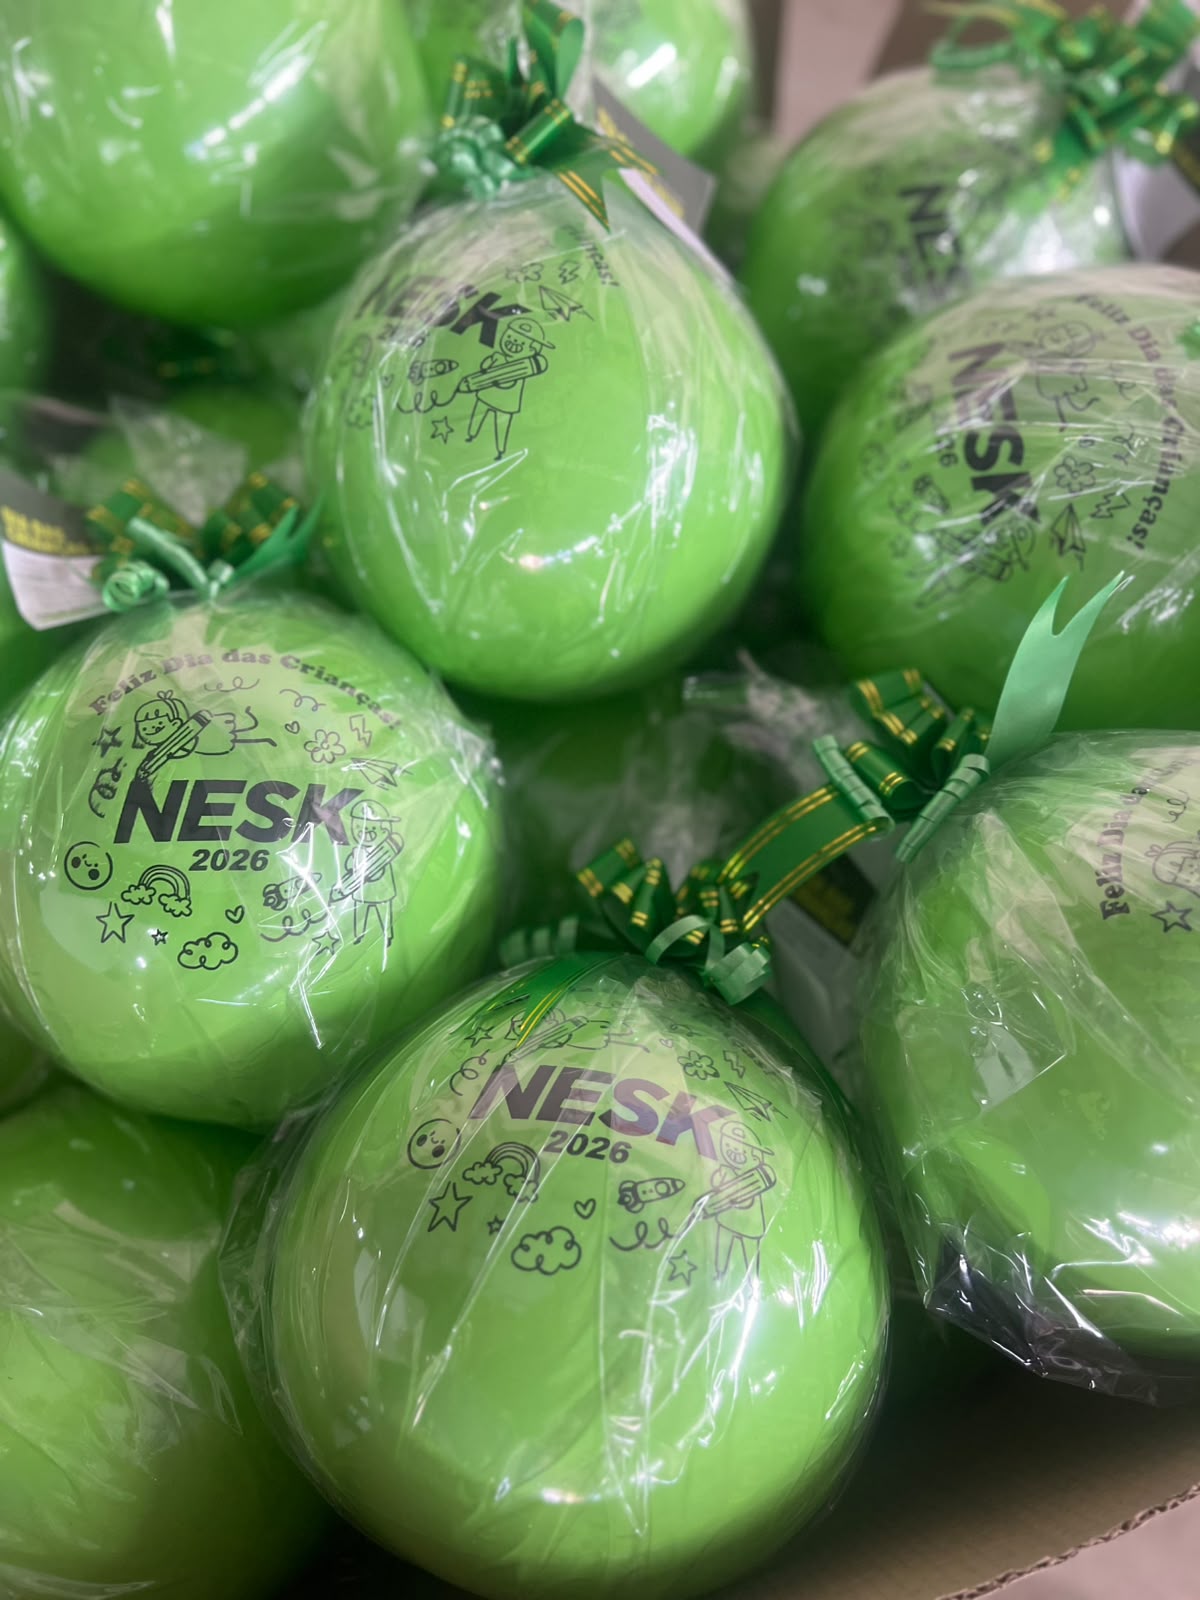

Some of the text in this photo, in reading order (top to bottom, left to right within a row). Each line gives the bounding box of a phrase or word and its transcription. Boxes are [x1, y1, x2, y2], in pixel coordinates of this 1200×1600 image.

[1127, 325, 1162, 362] Dia
[89, 669, 157, 716] Feliz
[161, 653, 213, 675] Dia
[221, 648, 273, 665] das
[113, 779, 364, 846] NESK
[188, 848, 270, 872] 2026
[469, 1064, 737, 1161] NESK
[543, 1129, 633, 1164] 2026
